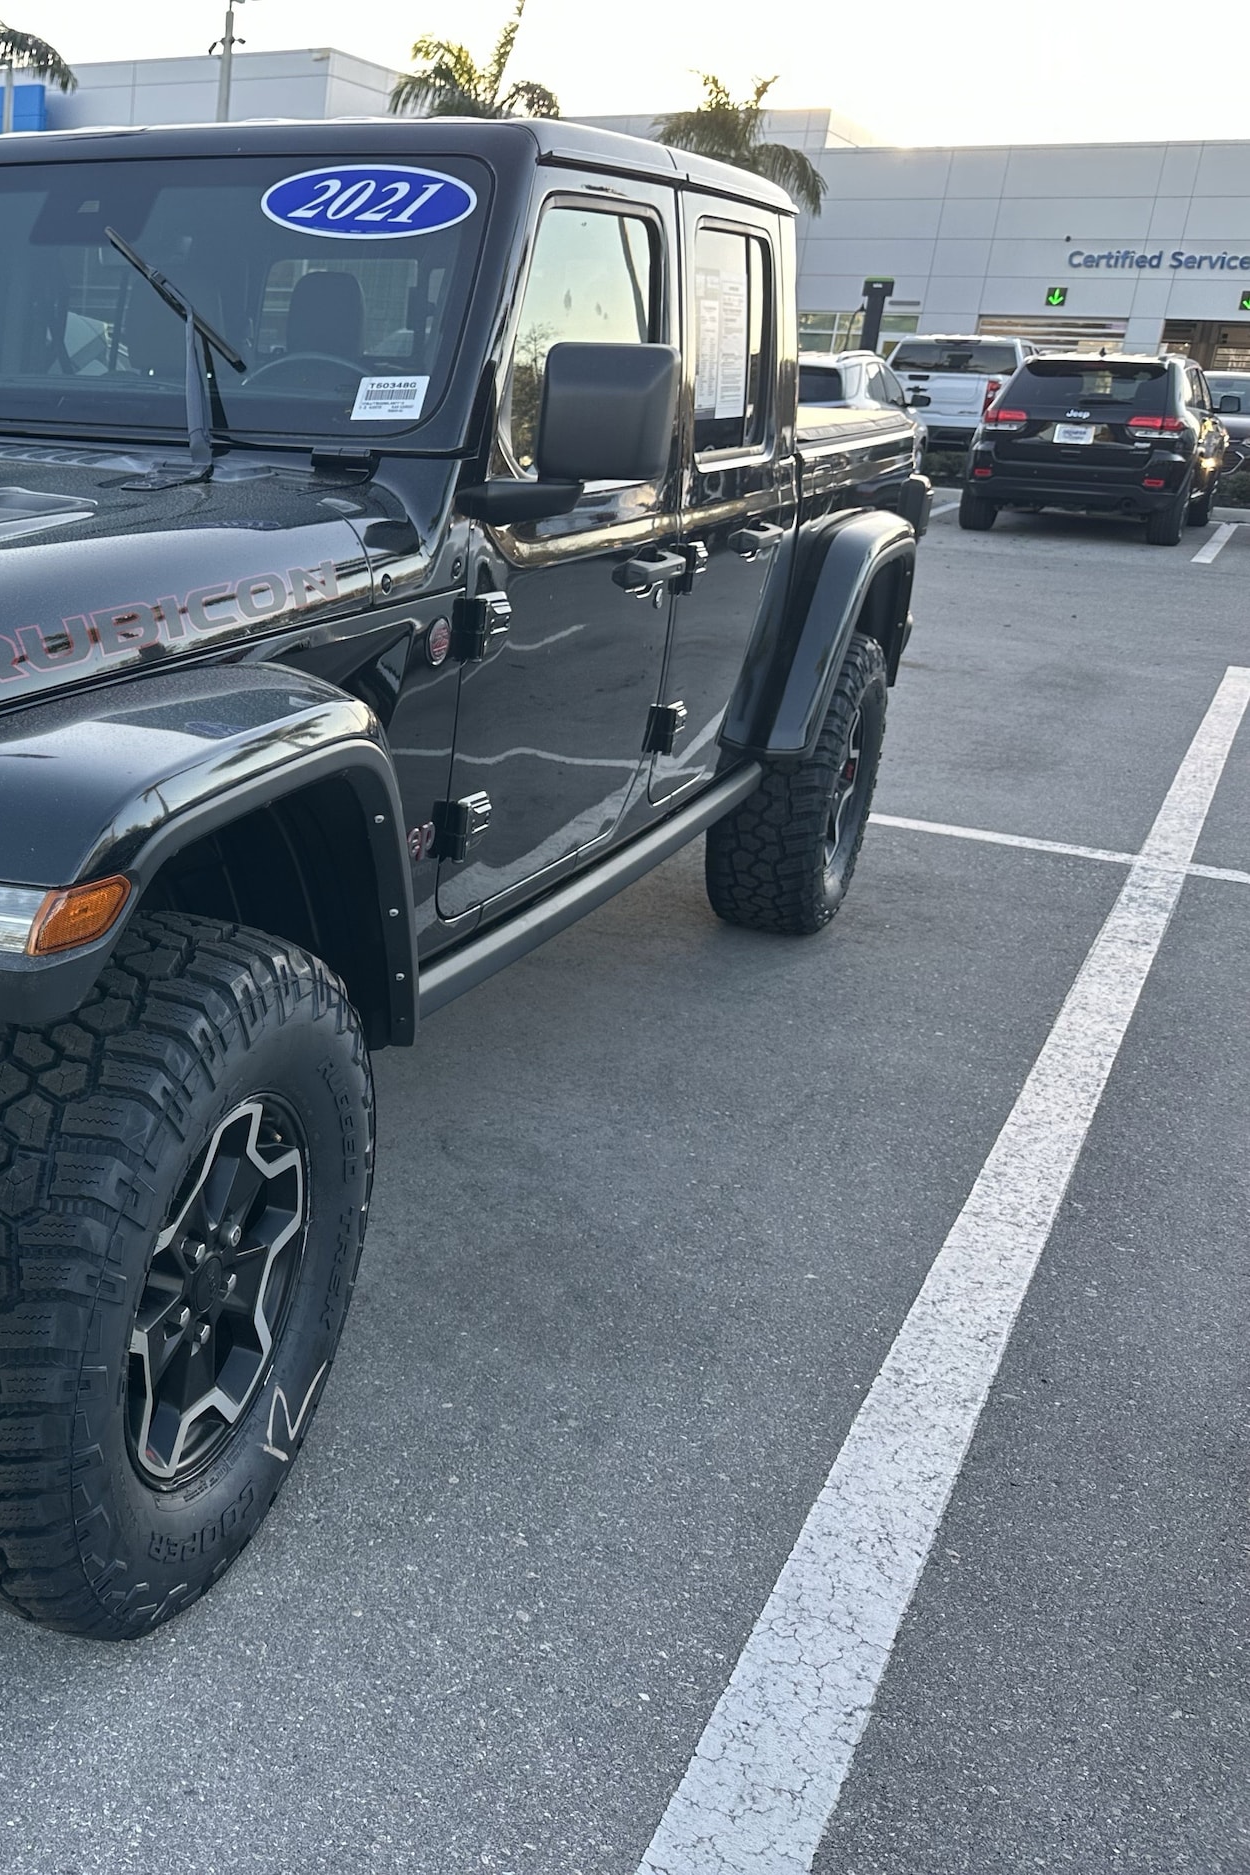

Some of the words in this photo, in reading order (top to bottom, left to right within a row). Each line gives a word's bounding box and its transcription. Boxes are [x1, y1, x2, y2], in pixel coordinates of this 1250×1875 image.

[287, 178, 445, 223] 2021
[1068, 250, 1164, 269] Certified
[1169, 251, 1250, 270] Service
[1065, 409, 1091, 419] Jeep
[316, 1055, 357, 1184] RUGGED
[319, 1205, 355, 1331] TREK
[148, 1479, 254, 1564] COOPER
